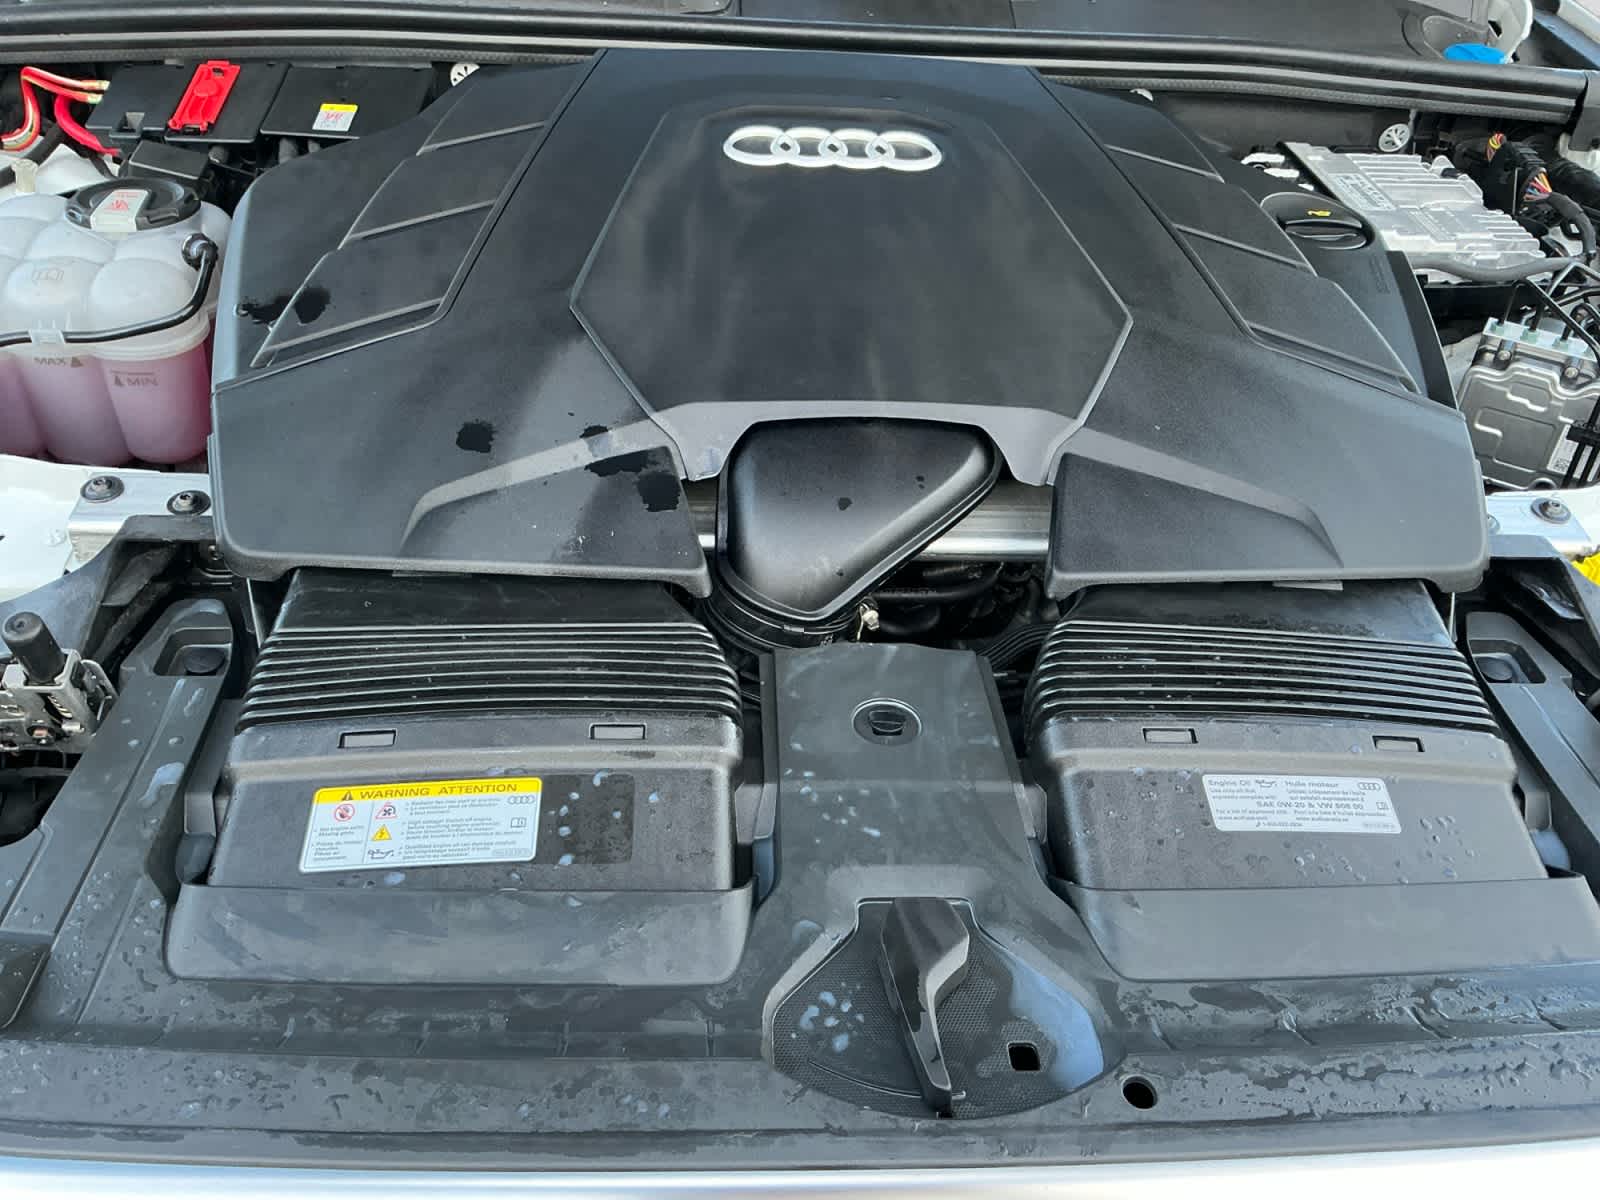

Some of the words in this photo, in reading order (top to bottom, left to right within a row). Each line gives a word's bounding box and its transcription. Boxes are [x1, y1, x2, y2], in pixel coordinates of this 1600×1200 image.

[33, 356, 66, 366] MAX
[127, 376, 159, 387] MIN
[1207, 779, 1237, 787] Engine
[360, 787, 430, 800] WARNING
[438, 783, 518, 796] ATTENTION
[1256, 800, 1275, 809] SAE
[1316, 802, 1334, 810] VW
